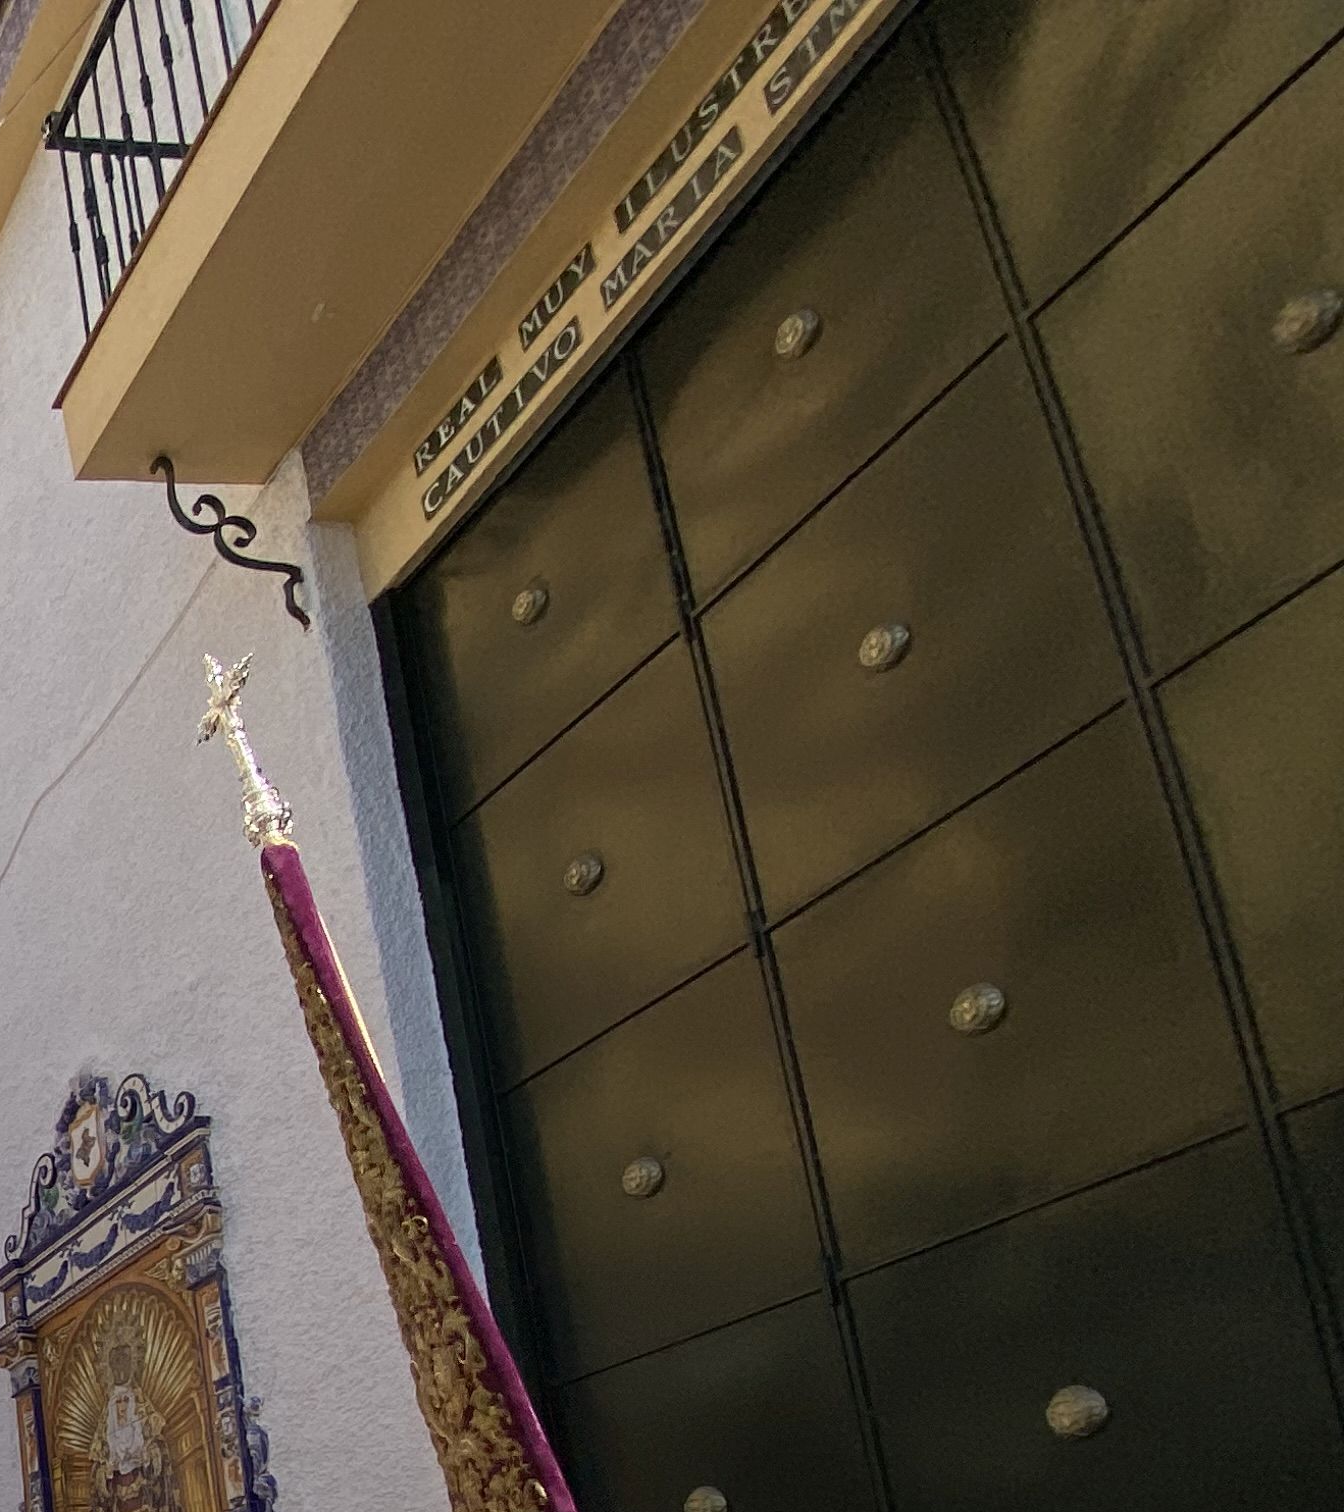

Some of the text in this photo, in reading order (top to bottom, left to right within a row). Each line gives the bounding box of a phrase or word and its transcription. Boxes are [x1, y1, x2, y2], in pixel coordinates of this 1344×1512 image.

[414, 0, 808, 476] REAL MUY ILUSTRE
[421, 318, 580, 518] CAUTIVO
[602, 138, 740, 309] MARIA
